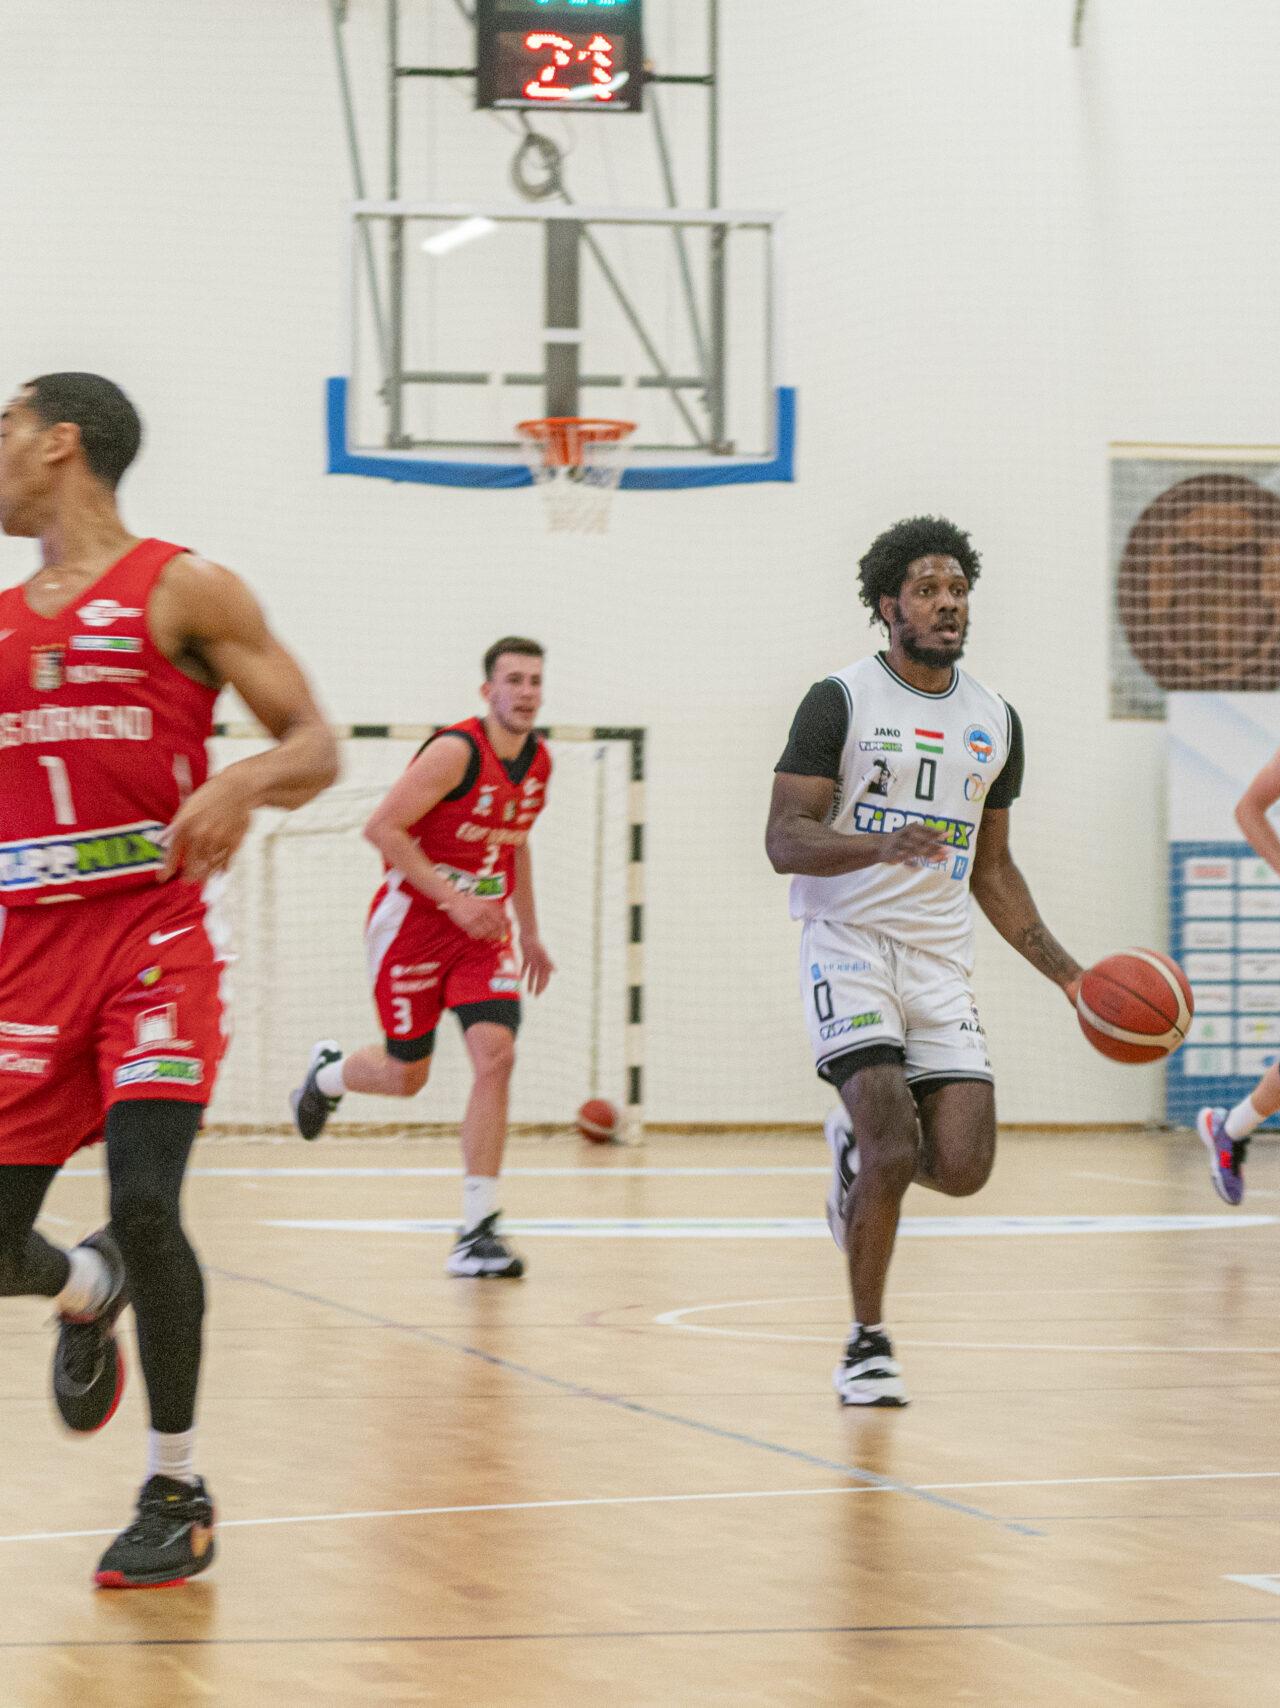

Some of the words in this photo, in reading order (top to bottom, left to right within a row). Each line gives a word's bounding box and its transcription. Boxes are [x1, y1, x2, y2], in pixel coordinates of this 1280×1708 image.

[524, 32, 614, 100] 21
[874, 727, 901, 738] JAKO
[38, 755, 77, 825] 1
[915, 757, 937, 801] 0
[391, 997, 413, 1034] 3
[814, 980, 834, 1022] 0
